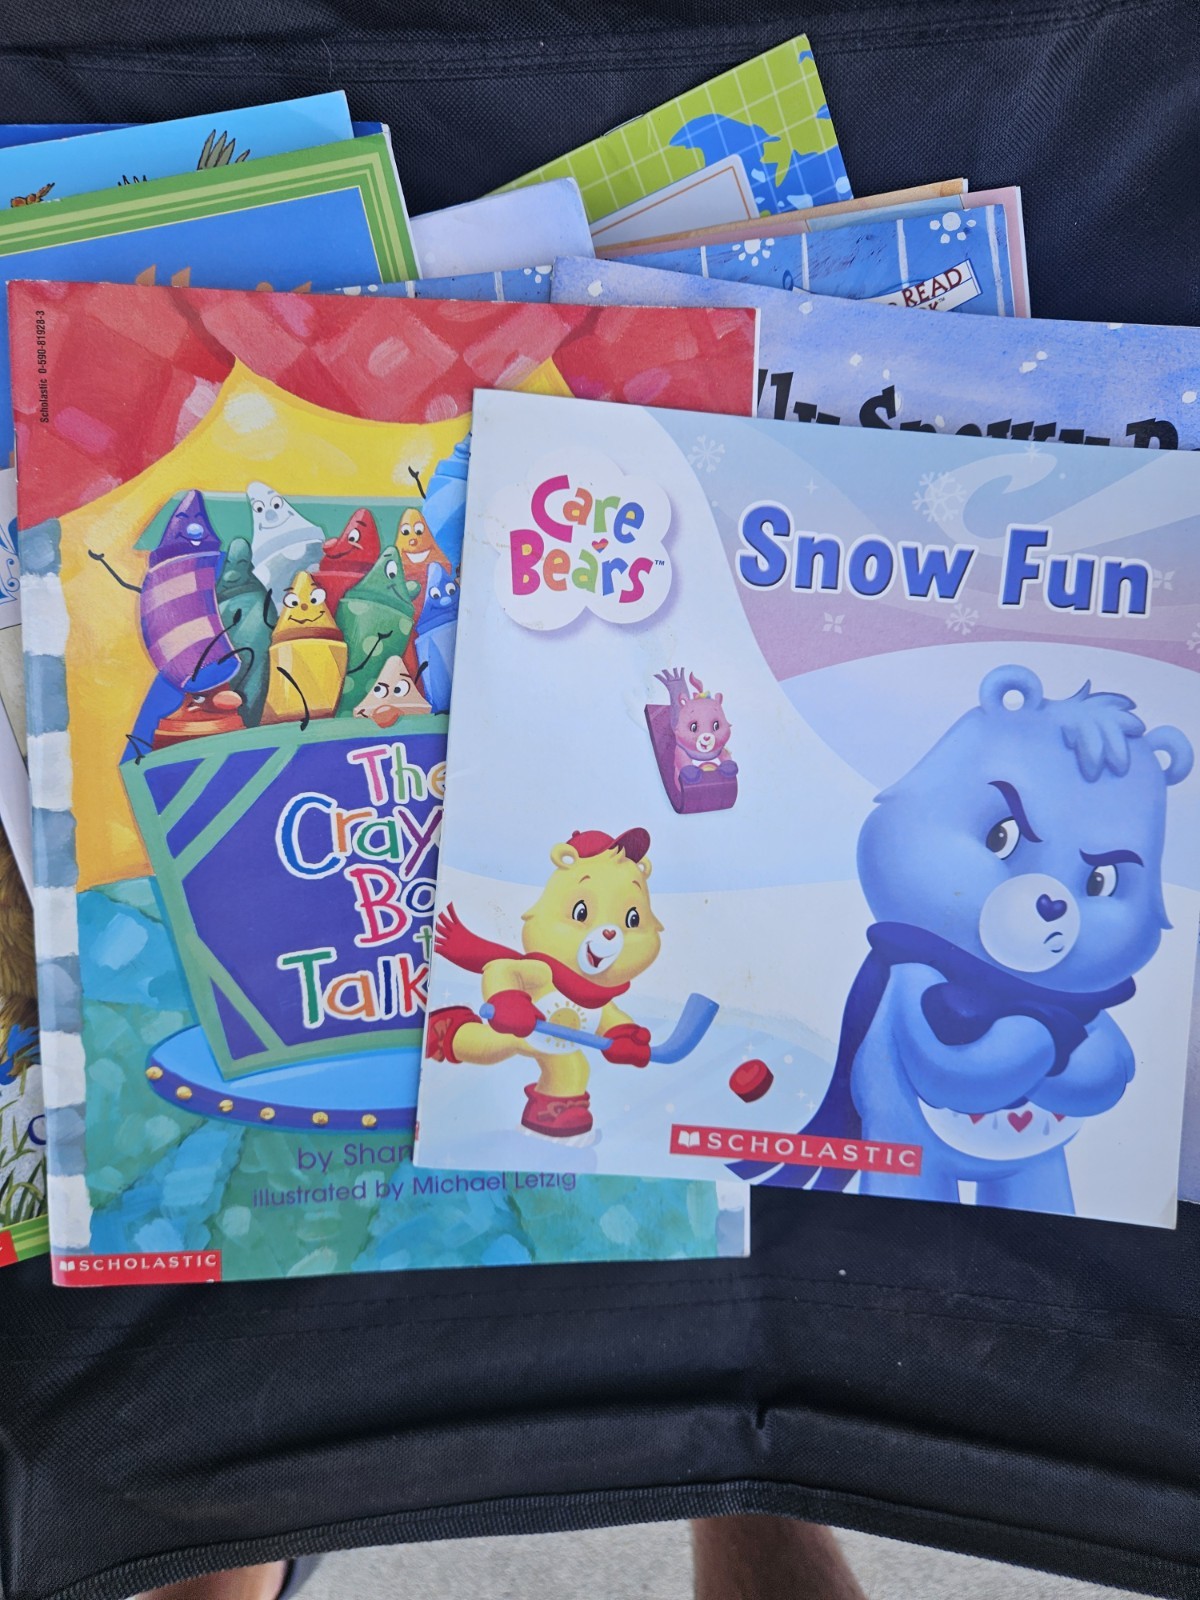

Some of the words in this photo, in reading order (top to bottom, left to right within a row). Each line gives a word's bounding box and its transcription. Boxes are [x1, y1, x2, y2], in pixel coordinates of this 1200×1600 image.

[902, 268, 962, 308] READ
[36, 310, 47, 374] 0-590-81928-3
[39, 378, 49, 423] Scholastic
[531, 474, 645, 544] Care
[738, 504, 976, 600] Snow
[1001, 527, 1150, 616] Fun
[279, 794, 444, 878] Cray
[297, 1147, 333, 1172] by
[707, 1132, 916, 1168] SCHOLASTIC
[252, 1181, 367, 1208] illustrated
[375, 1179, 404, 1200] by
[413, 1171, 506, 1195] Michael
[79, 1254, 217, 1272] SCHOLASTIC
